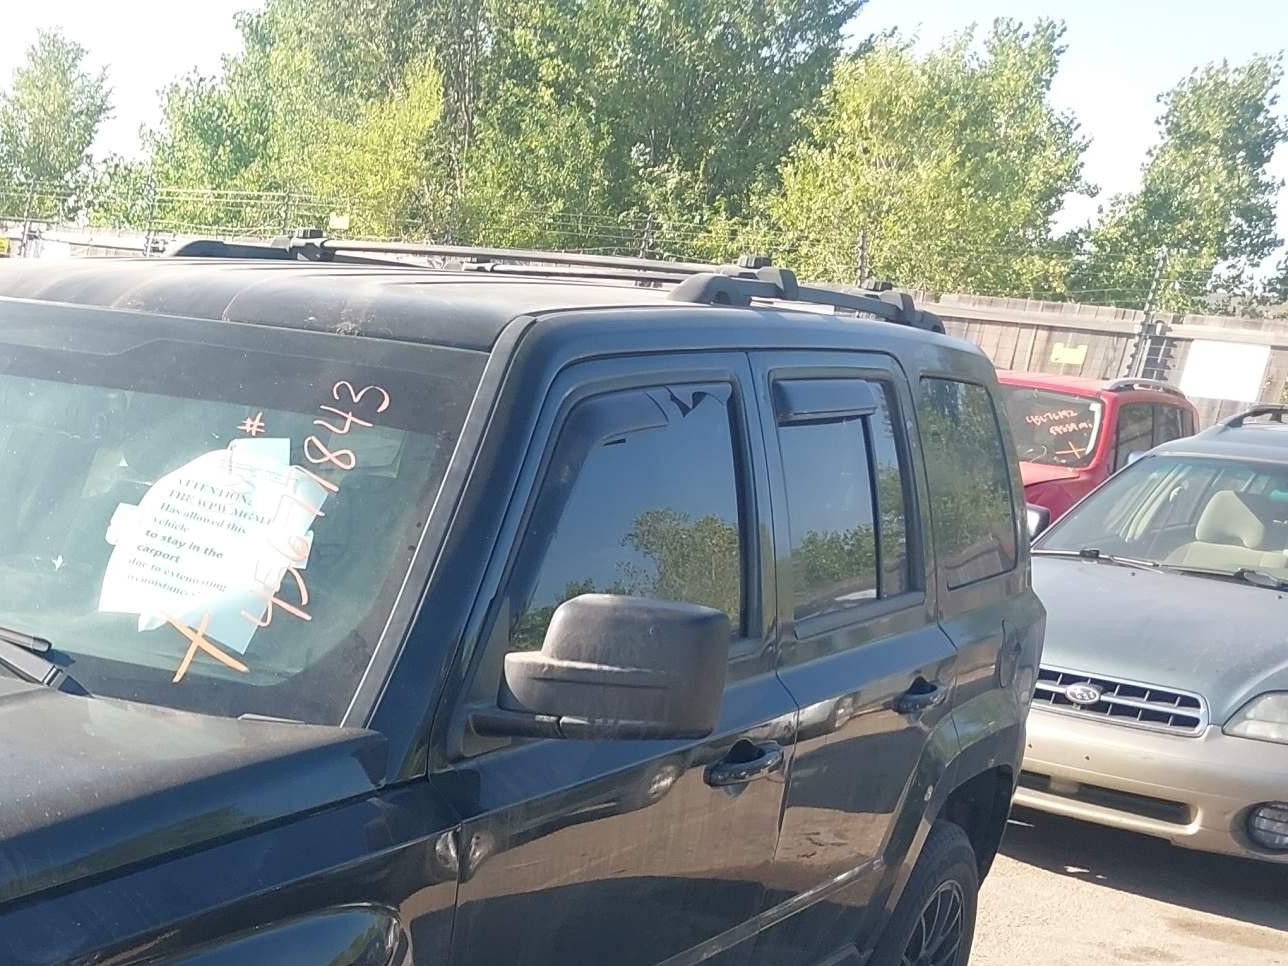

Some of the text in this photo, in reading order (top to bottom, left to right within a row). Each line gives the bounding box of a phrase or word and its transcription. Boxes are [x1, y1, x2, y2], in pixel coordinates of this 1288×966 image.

[136, 544, 181, 564] carport
[145, 529, 224, 559] to stay in the
